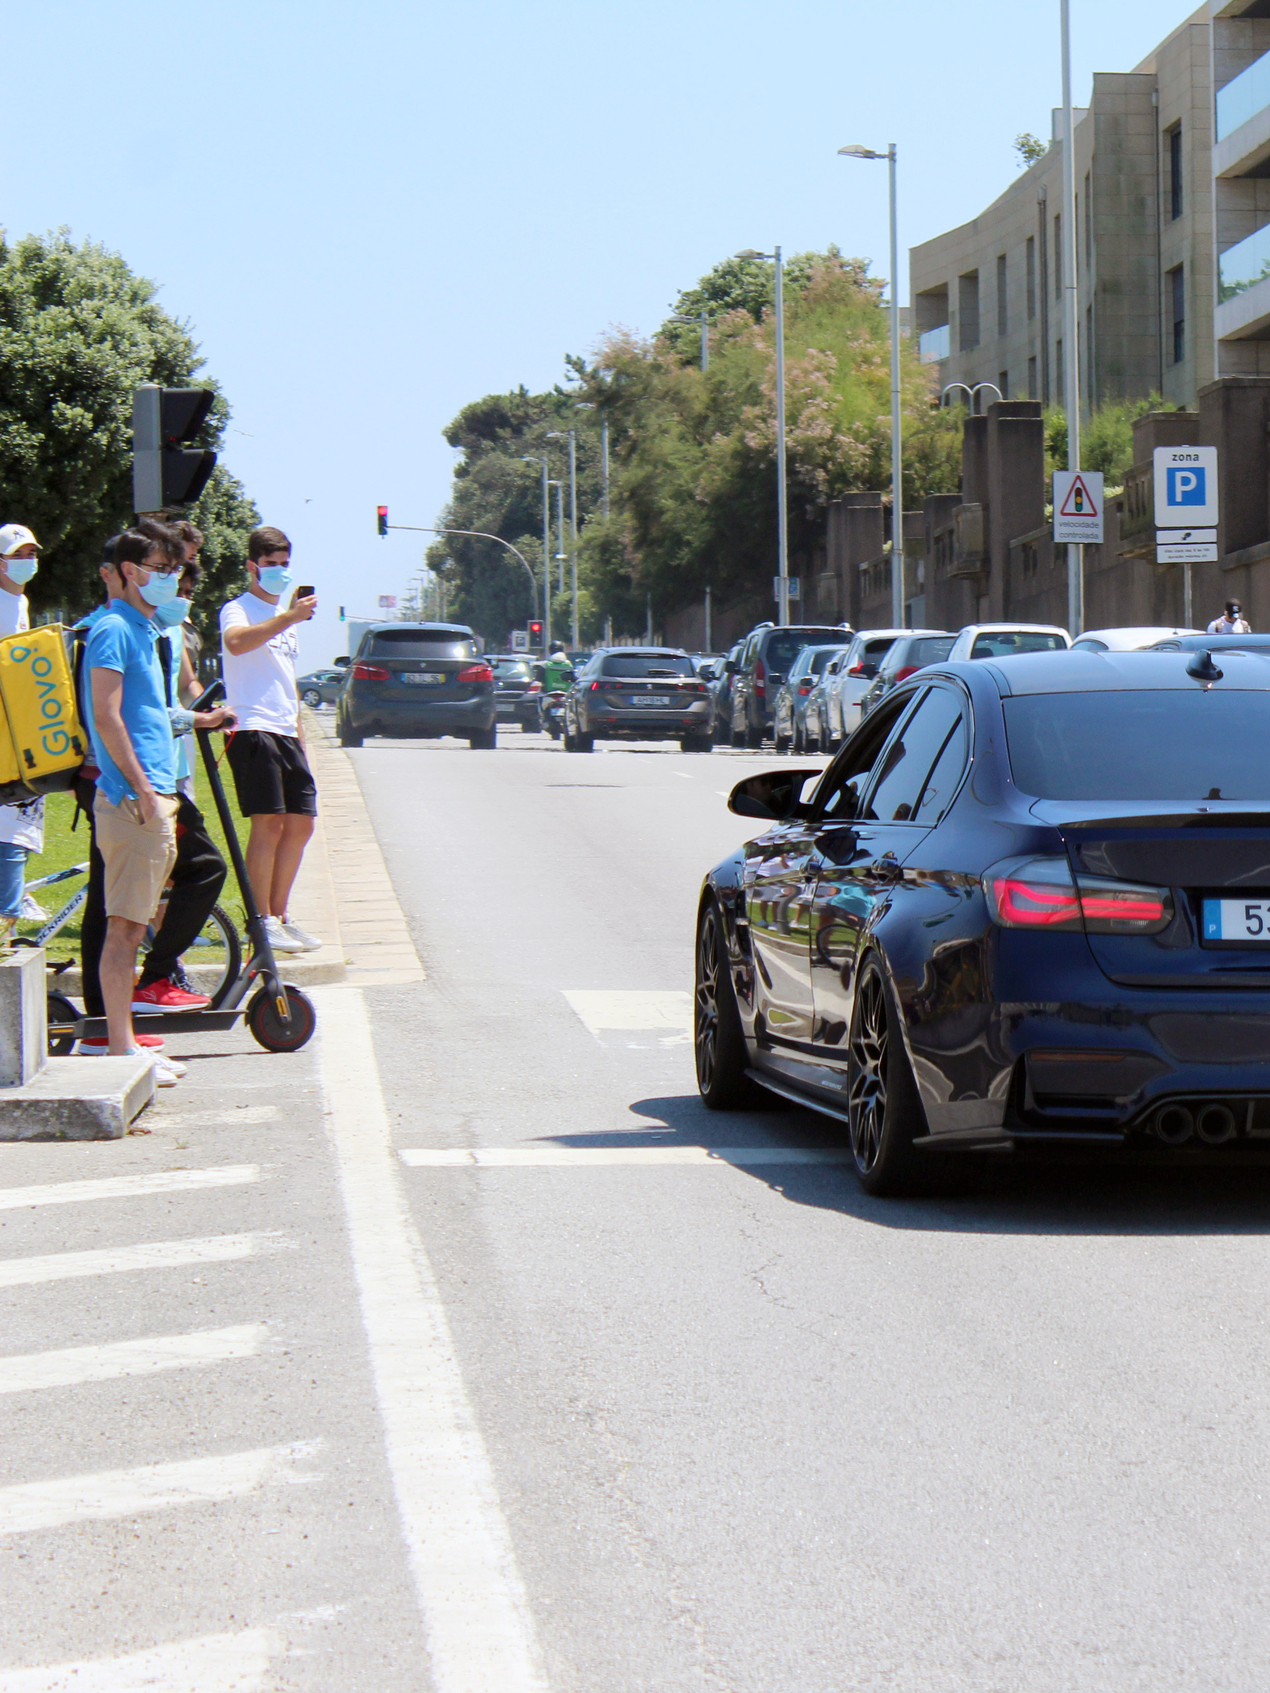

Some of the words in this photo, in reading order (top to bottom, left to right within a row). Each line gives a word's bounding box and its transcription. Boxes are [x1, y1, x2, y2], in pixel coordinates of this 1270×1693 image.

[1172, 454, 1200, 462] zona
[1175, 471, 1198, 503] P
[1059, 520, 1100, 529] velocidade
[1059, 531, 1099, 540] controlada
[31, 656, 70, 757] Glovo
[36, 894, 83, 945] OCKRIDER
